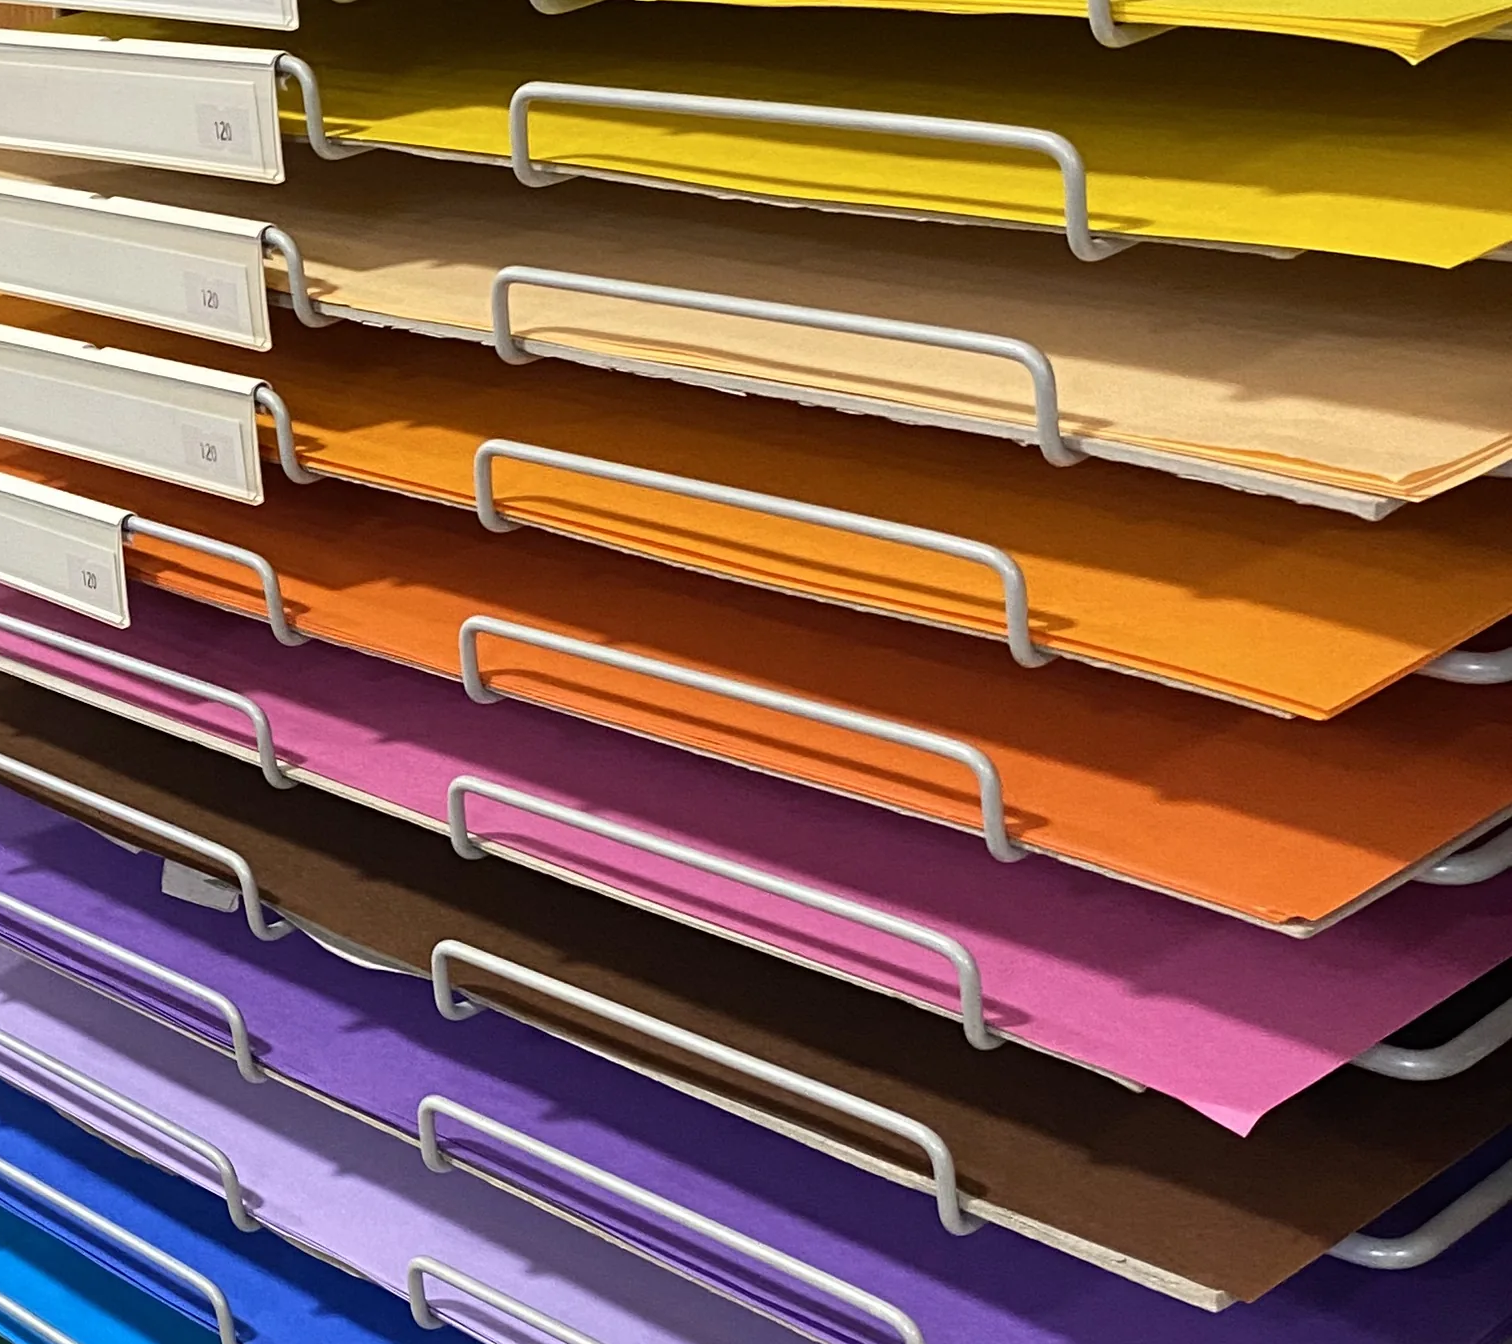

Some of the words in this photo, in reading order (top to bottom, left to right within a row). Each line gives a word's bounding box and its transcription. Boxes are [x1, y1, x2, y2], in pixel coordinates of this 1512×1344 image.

[214, 120, 233, 142] 120
[201, 288, 219, 310] 120
[199, 442, 217, 463] 120
[81, 570, 97, 590] 120
